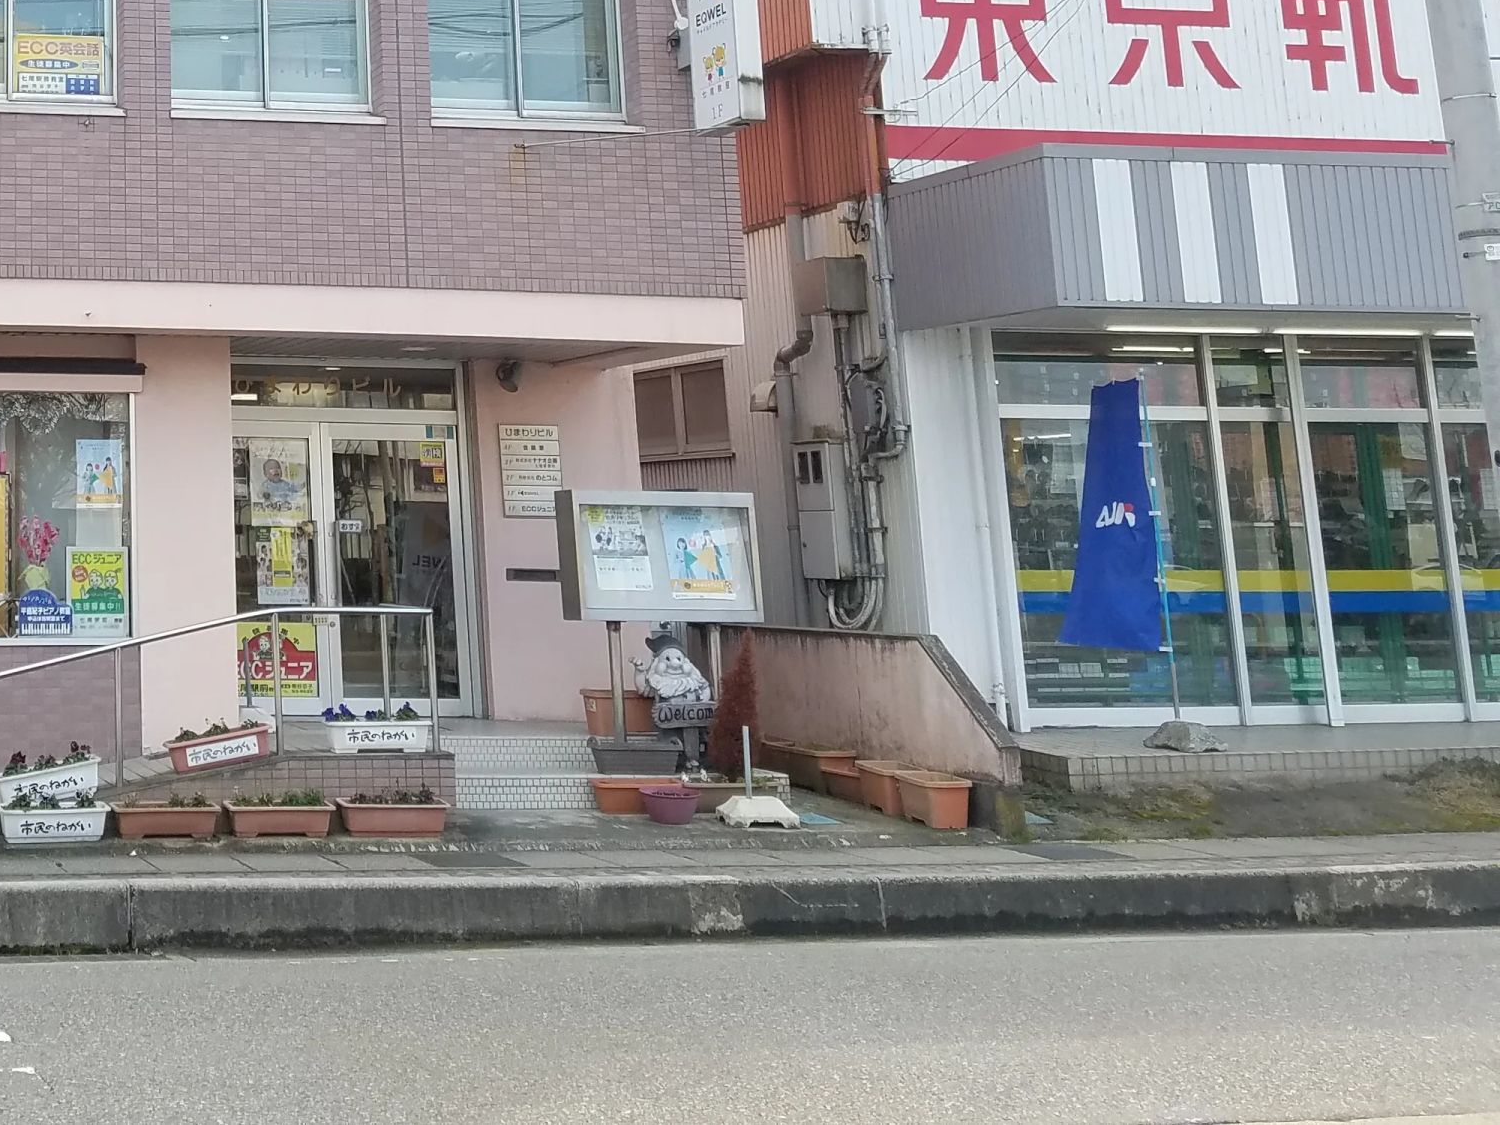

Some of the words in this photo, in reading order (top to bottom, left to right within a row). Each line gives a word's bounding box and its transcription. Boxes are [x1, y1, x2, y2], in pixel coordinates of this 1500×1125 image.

[695, 2, 727, 27] EQWEL
[17, 40, 100, 57] ECC英会話
[505, 428, 553, 437] ひまわりビル
[72, 553, 122, 565] ECCジュニア
[658, 705, 715, 723] Welcom
[346, 729, 416, 743] 市民のねがい
[188, 741, 258, 764] 市民のねがい
[14, 775, 85, 795] 市民のねがい
[20, 820, 92, 836] 市民のねがい
